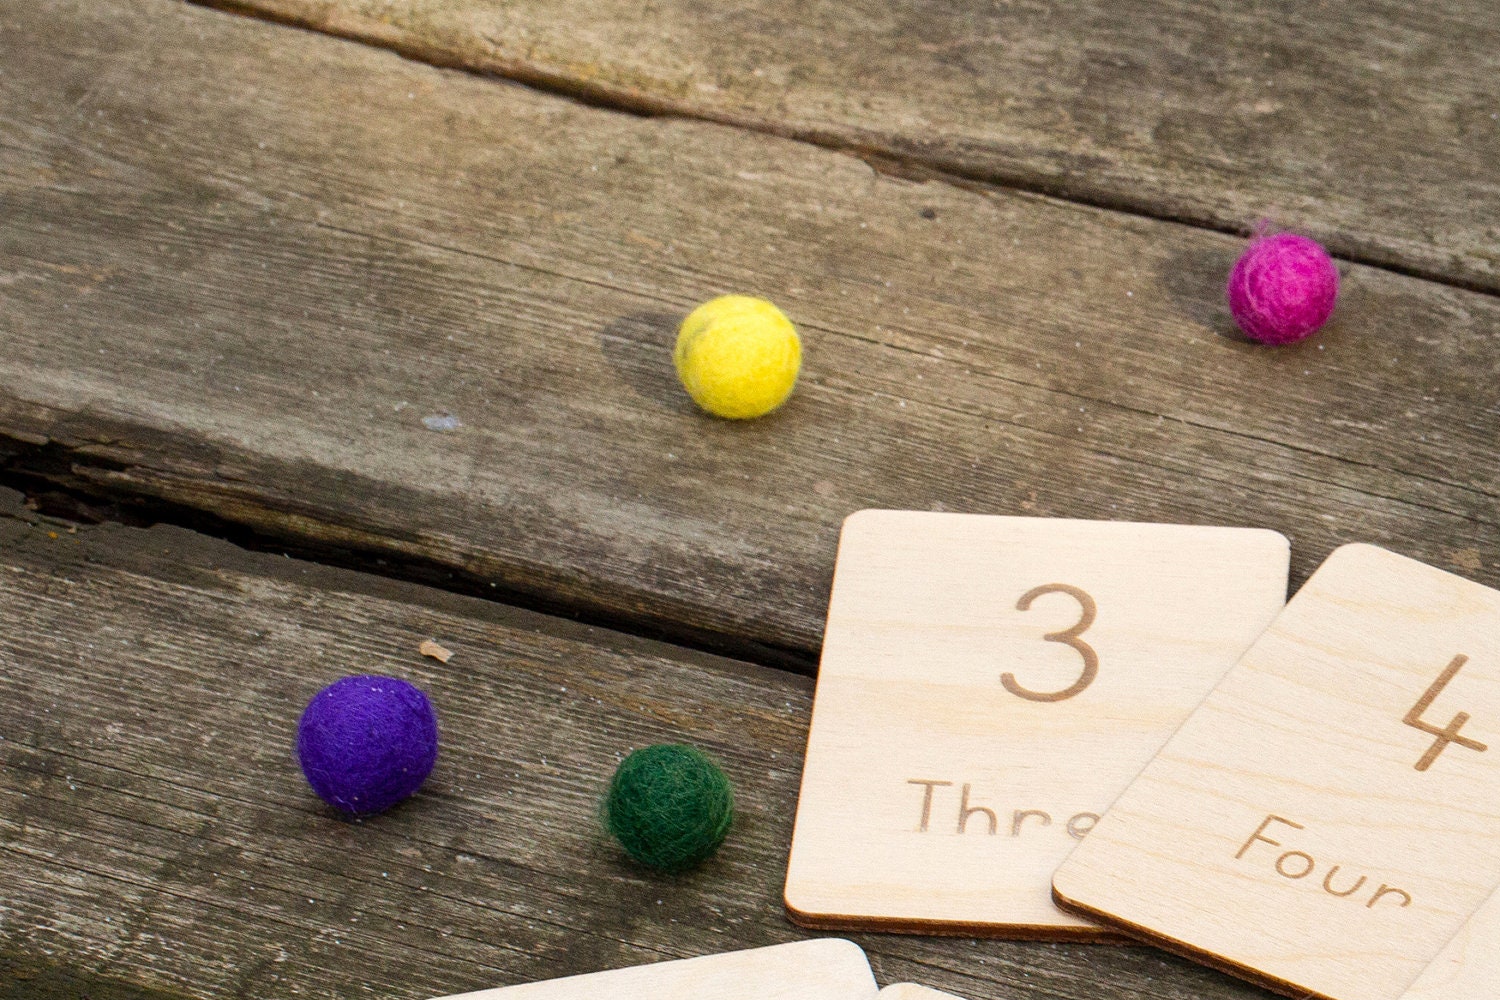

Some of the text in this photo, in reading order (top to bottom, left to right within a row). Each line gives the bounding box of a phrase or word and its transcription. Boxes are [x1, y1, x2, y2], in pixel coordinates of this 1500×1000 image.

[1000, 582, 1100, 703] 3
[1401, 653, 1488, 772] 4
[907, 779, 1102, 841] Thre
[1234, 813, 1413, 910] Four
